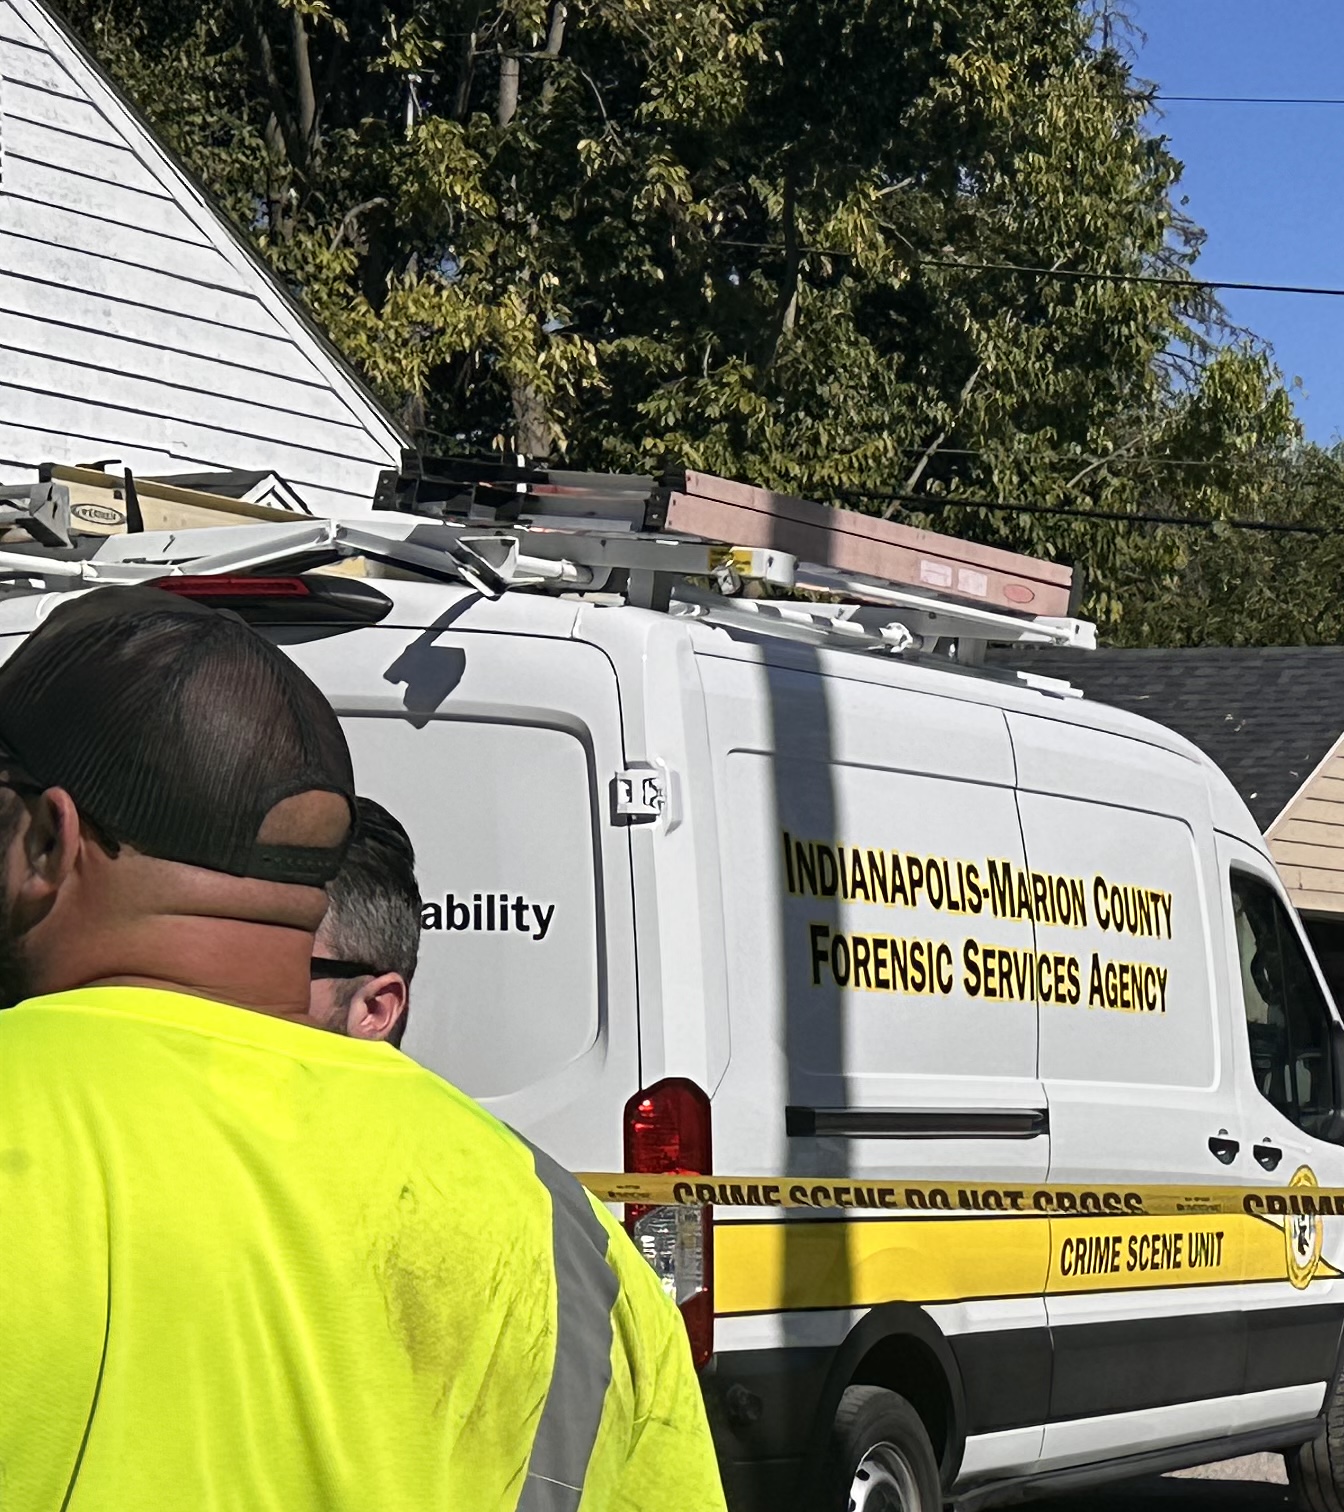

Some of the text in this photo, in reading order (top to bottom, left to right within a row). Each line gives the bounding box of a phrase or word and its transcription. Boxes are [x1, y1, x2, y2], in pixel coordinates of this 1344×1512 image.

[420, 893, 555, 941] ability
[1093, 875, 1173, 940] COUNTY
[809, 923, 1169, 1013] FORENSIC SERVICES AGENCY
[1060, 1231, 1225, 1276] CRIME SCENE UNIT
